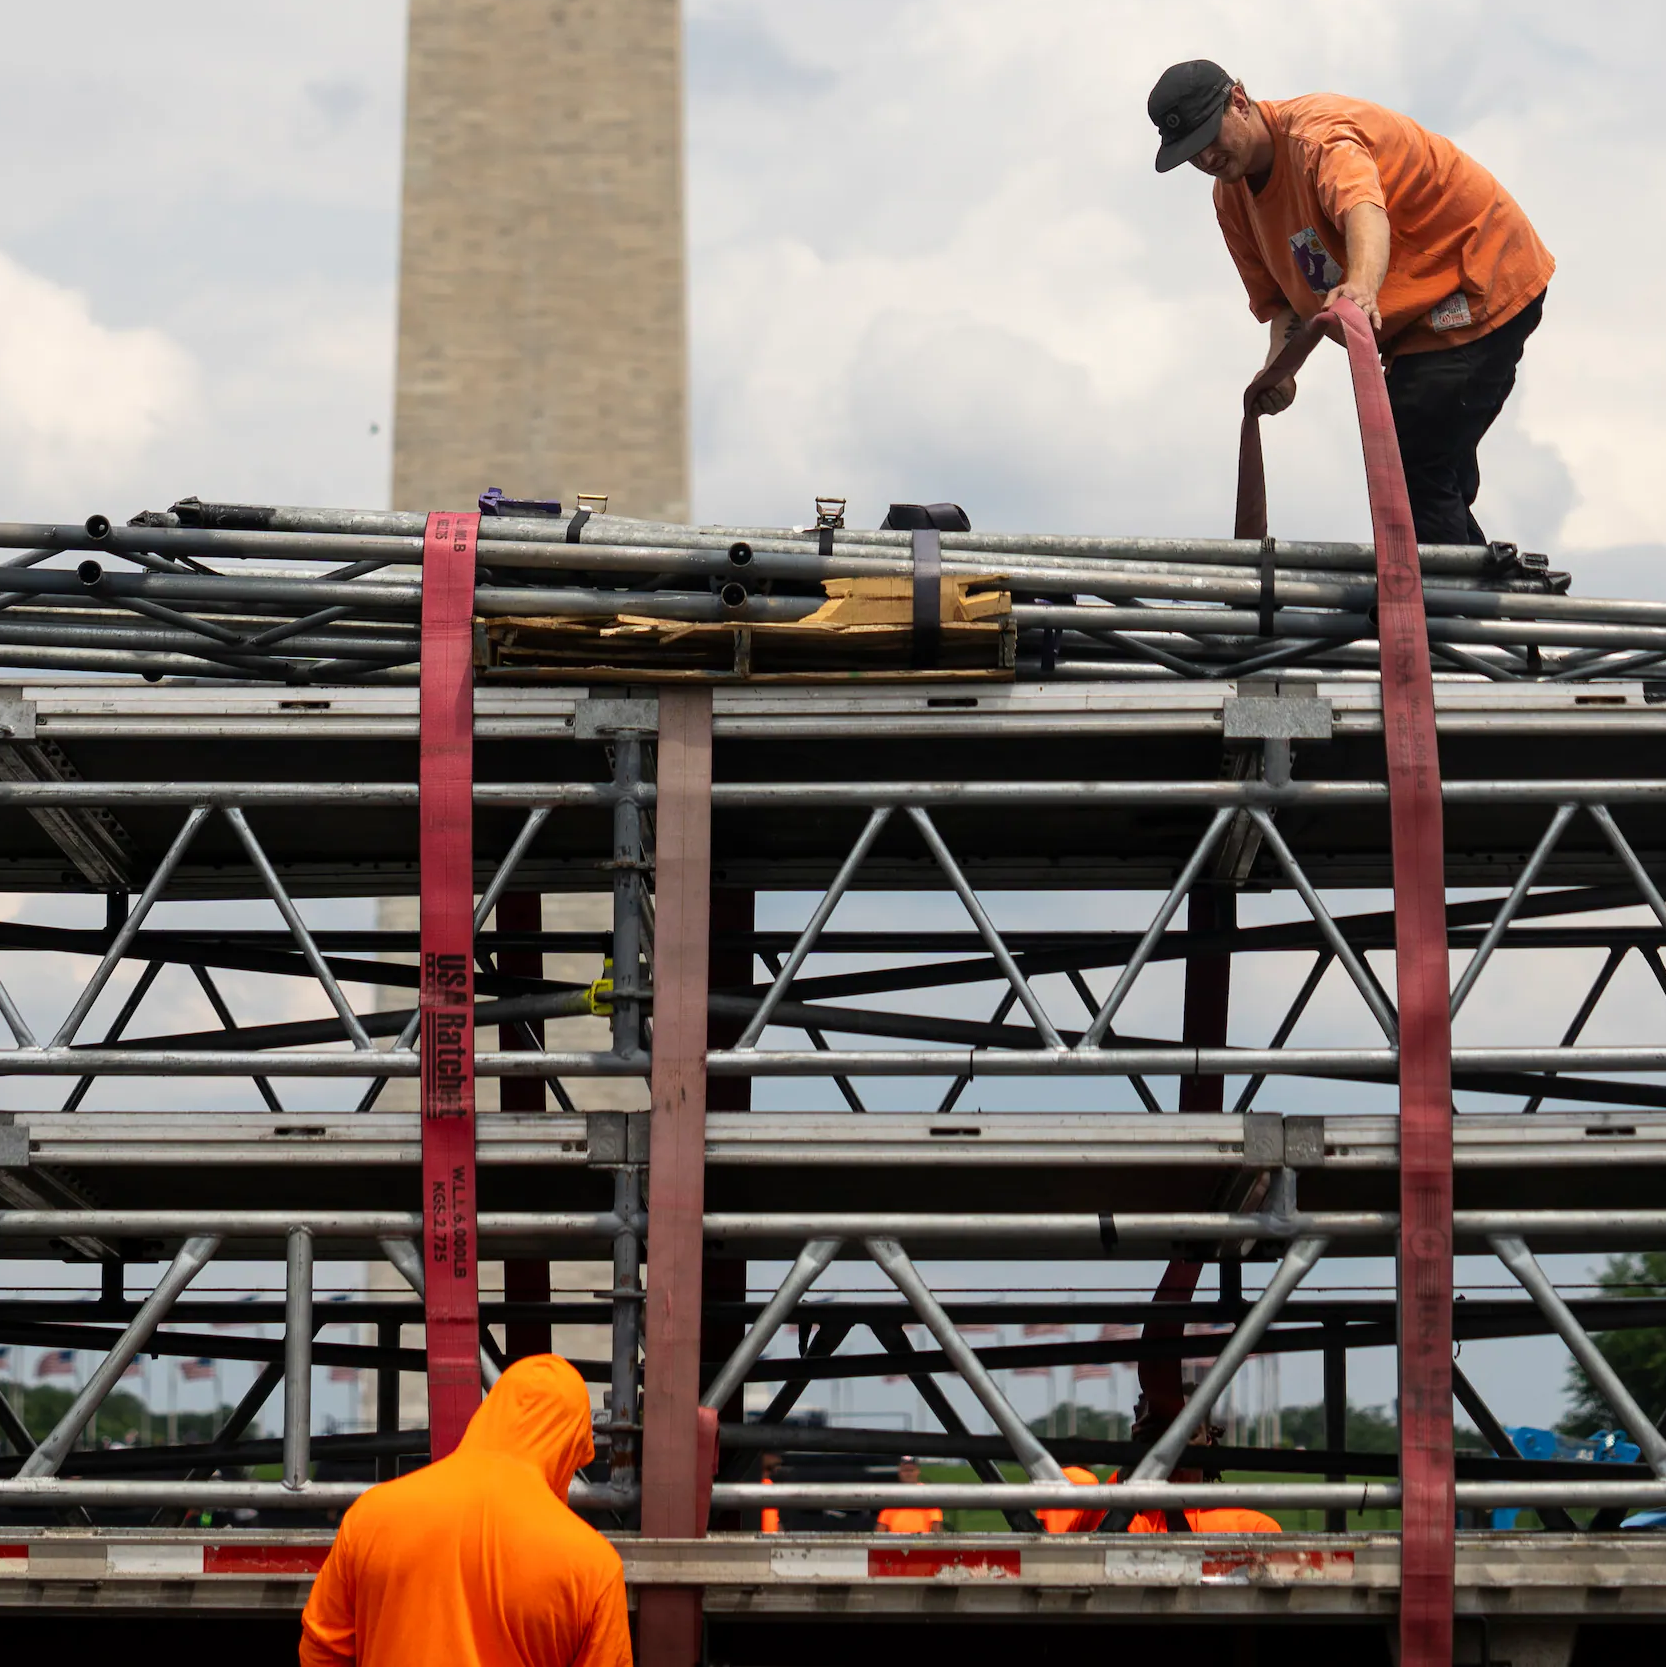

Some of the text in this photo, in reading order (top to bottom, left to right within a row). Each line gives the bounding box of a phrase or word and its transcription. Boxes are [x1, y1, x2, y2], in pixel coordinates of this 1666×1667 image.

[1395, 637, 1416, 688] USA
[437, 954, 467, 1120] USA Ratchet
